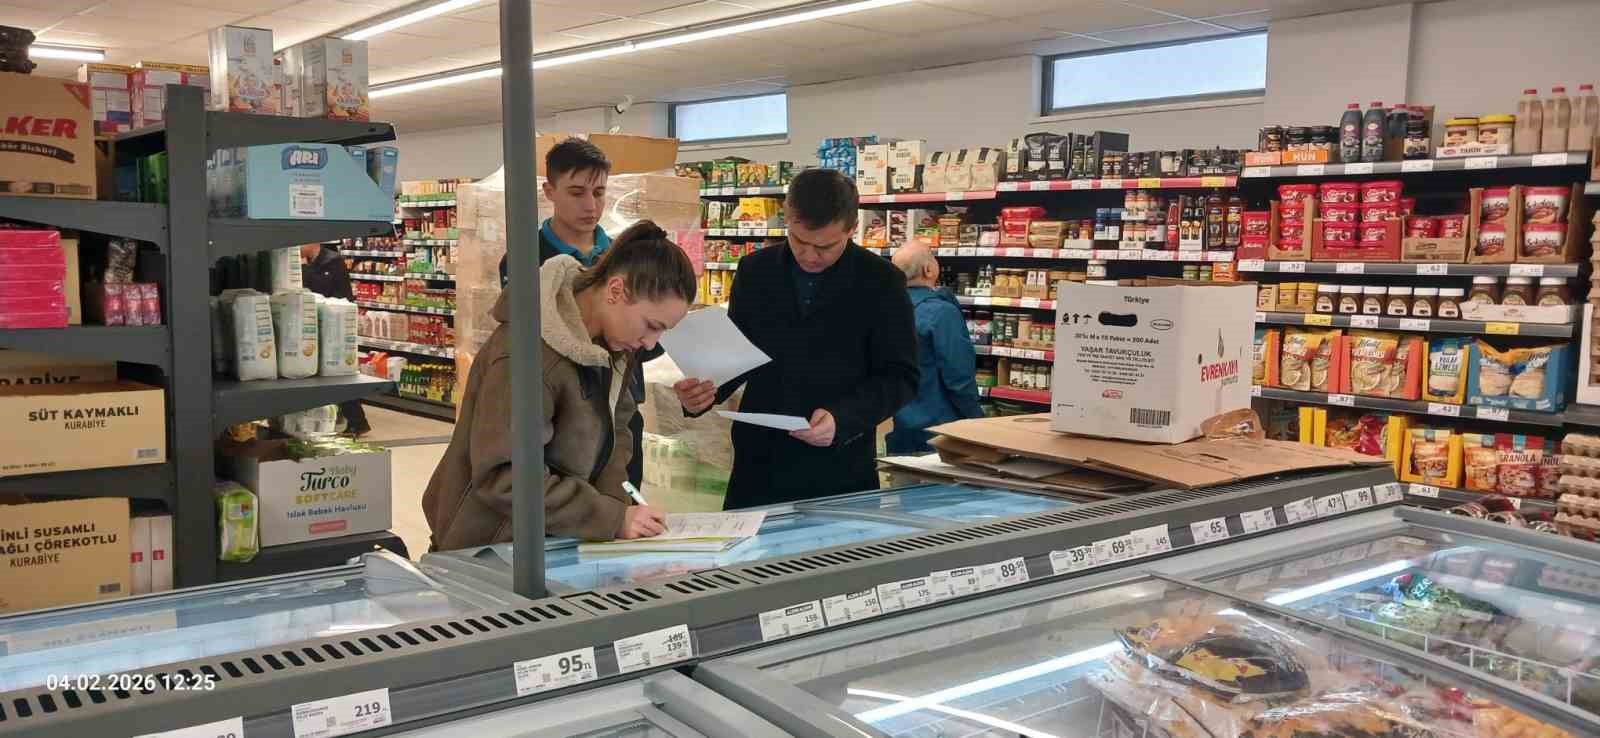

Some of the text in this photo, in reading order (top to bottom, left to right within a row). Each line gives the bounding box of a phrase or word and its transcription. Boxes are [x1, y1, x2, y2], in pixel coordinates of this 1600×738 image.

[28, 405, 139, 422] SÜT KAYMAKLI
[64, 419, 107, 431] KURABİYE
[300, 467, 350, 492] Turco
[33, 523, 96, 538] SUSAMLI
[1210, 520, 1222, 533] 65
[34, 534, 117, 553] ÇÖREKOTLU
[9, 553, 61, 568] KURABİYE
[354, 701, 382, 717] 219
